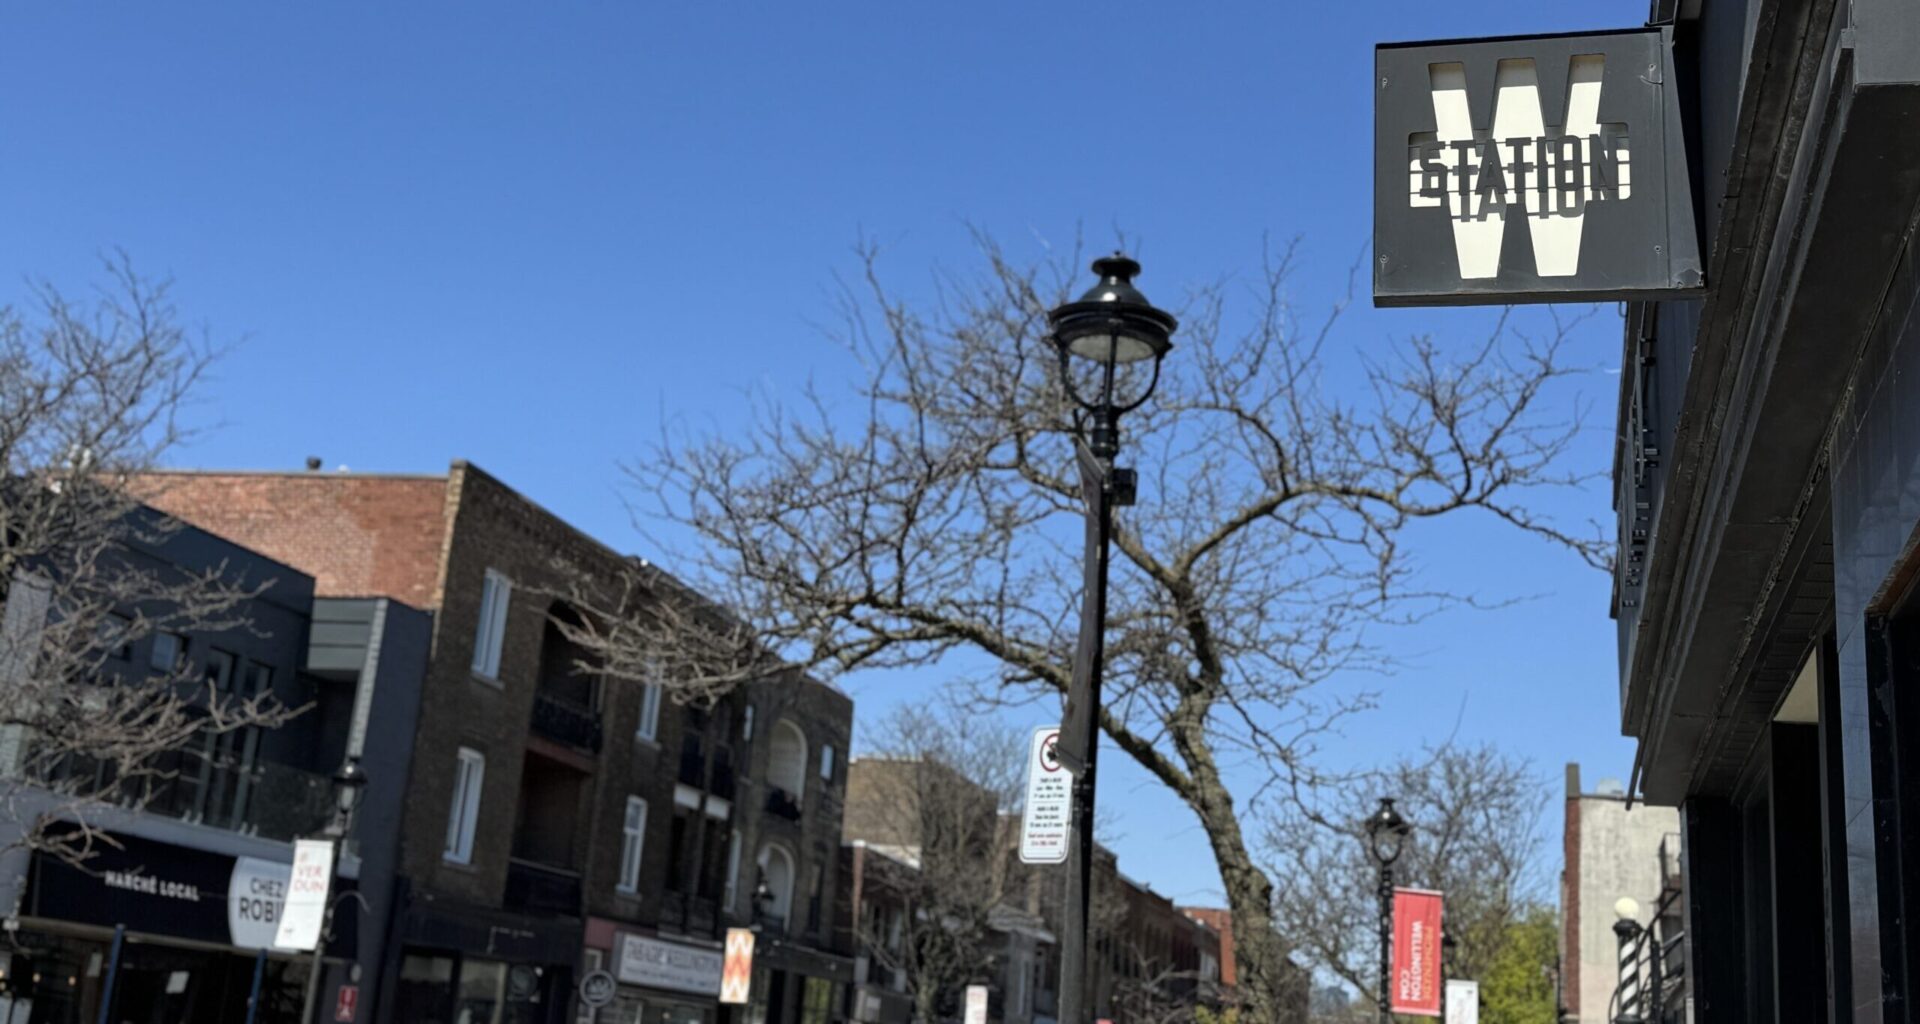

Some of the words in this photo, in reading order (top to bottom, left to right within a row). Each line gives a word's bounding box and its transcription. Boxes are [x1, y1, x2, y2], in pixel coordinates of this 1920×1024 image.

[1419, 133, 1619, 198] STATION
[1428, 53, 1606, 279] W
[105, 870, 157, 894] MARCHÉ
[160, 880, 200, 901] LOCAL
[250, 877, 284, 898] CHEZ
[239, 897, 286, 924] ROBI
[1411, 920, 1423, 1001] WELLINGTON
